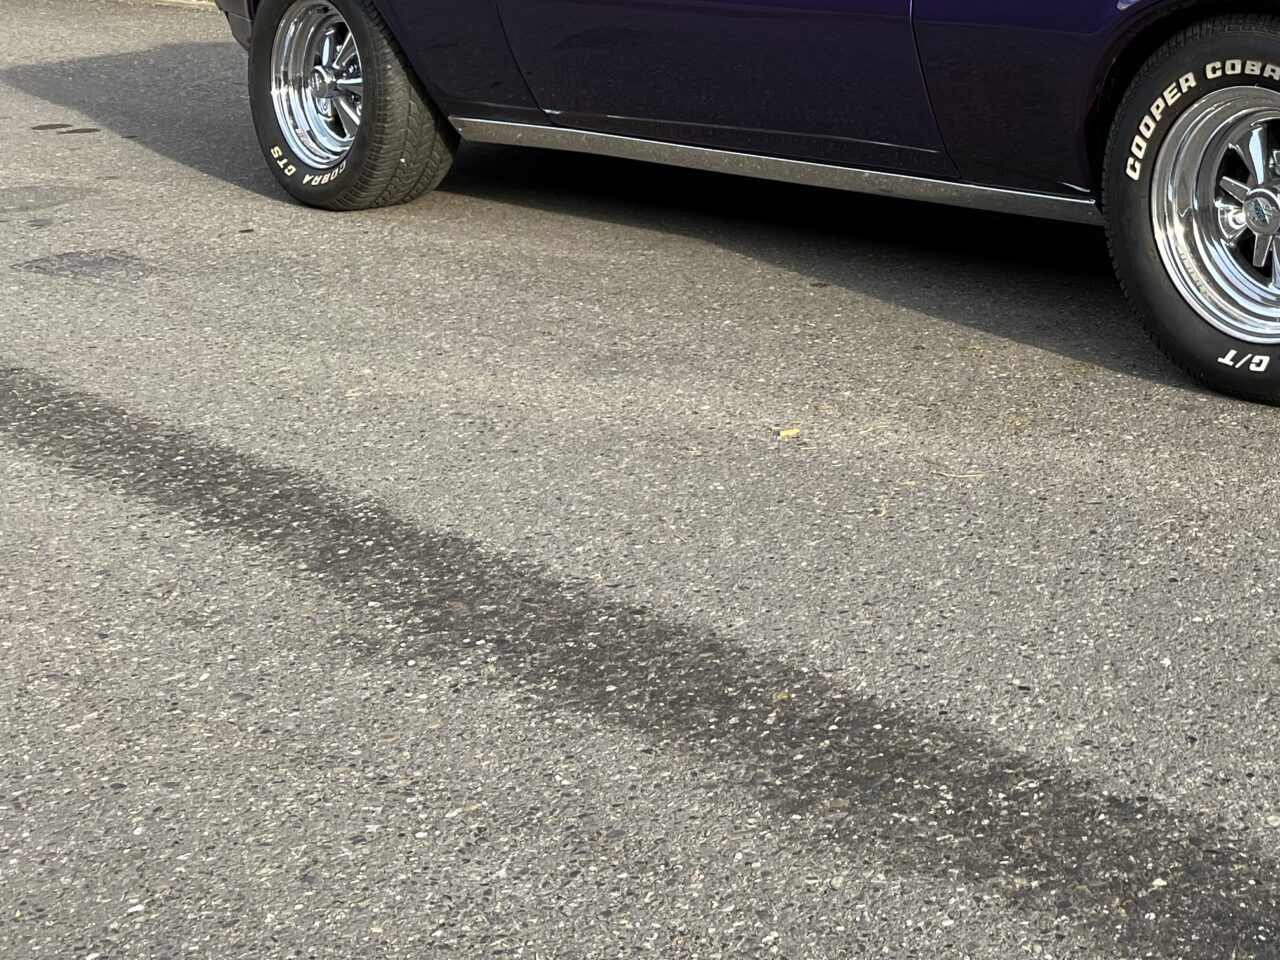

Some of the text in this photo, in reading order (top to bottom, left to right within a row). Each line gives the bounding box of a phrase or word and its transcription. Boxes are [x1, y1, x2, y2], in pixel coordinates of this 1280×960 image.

[1125, 71, 1197, 181] COOPER
[270, 145, 347, 186] COBRA GTS
[1217, 349, 1270, 372] G/T
